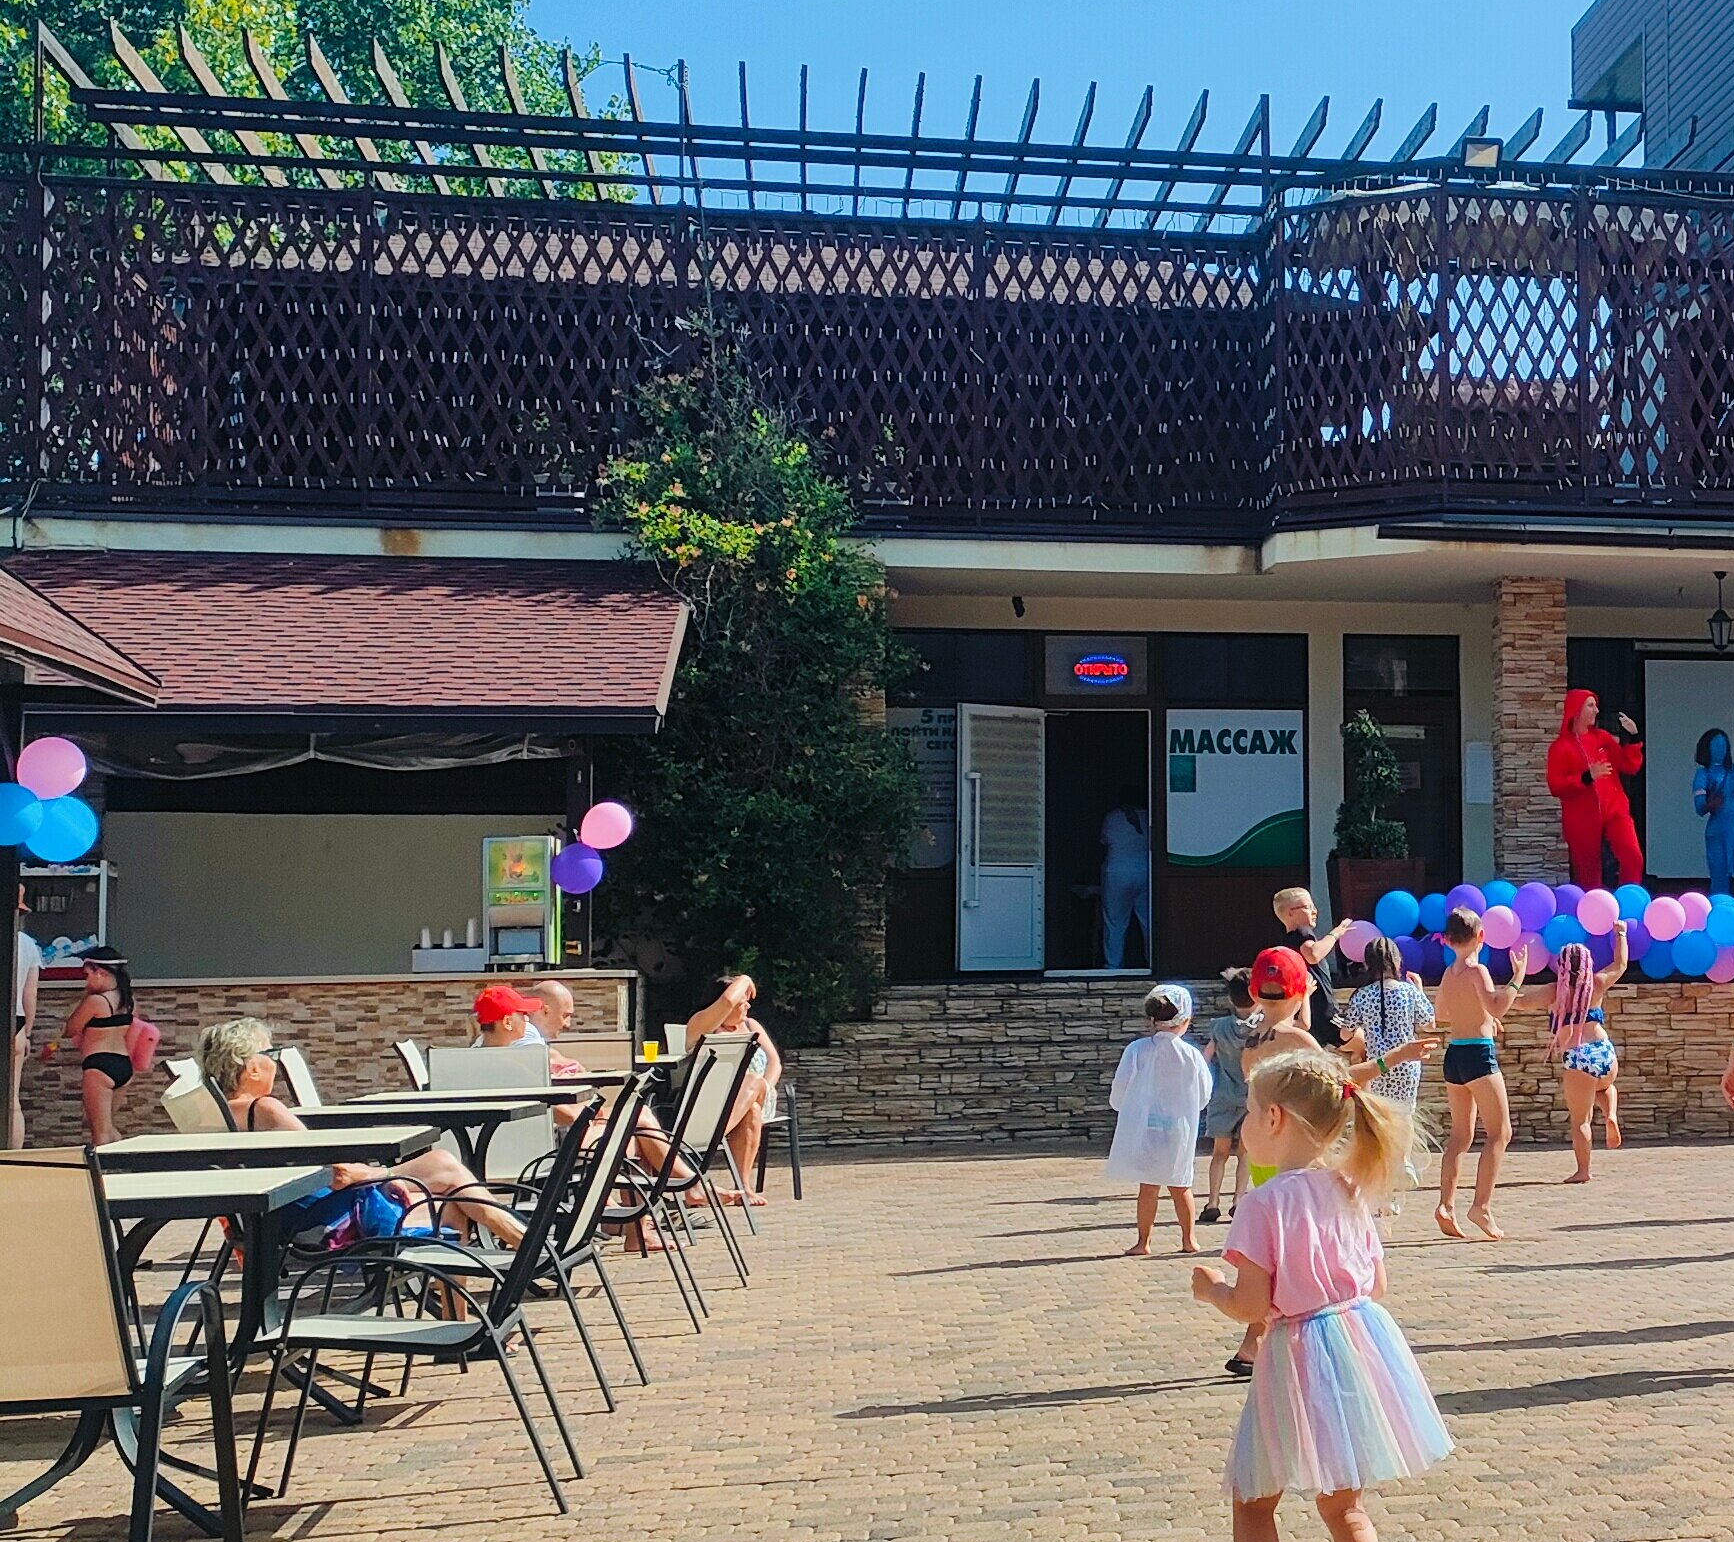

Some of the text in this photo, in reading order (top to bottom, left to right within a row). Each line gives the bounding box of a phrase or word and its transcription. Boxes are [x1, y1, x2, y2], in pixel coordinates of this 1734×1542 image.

[1074, 663, 1128, 676] ОТКРЫТО
[920, 709, 934, 724] 5
[1169, 728, 1298, 755] МАССАЖ
